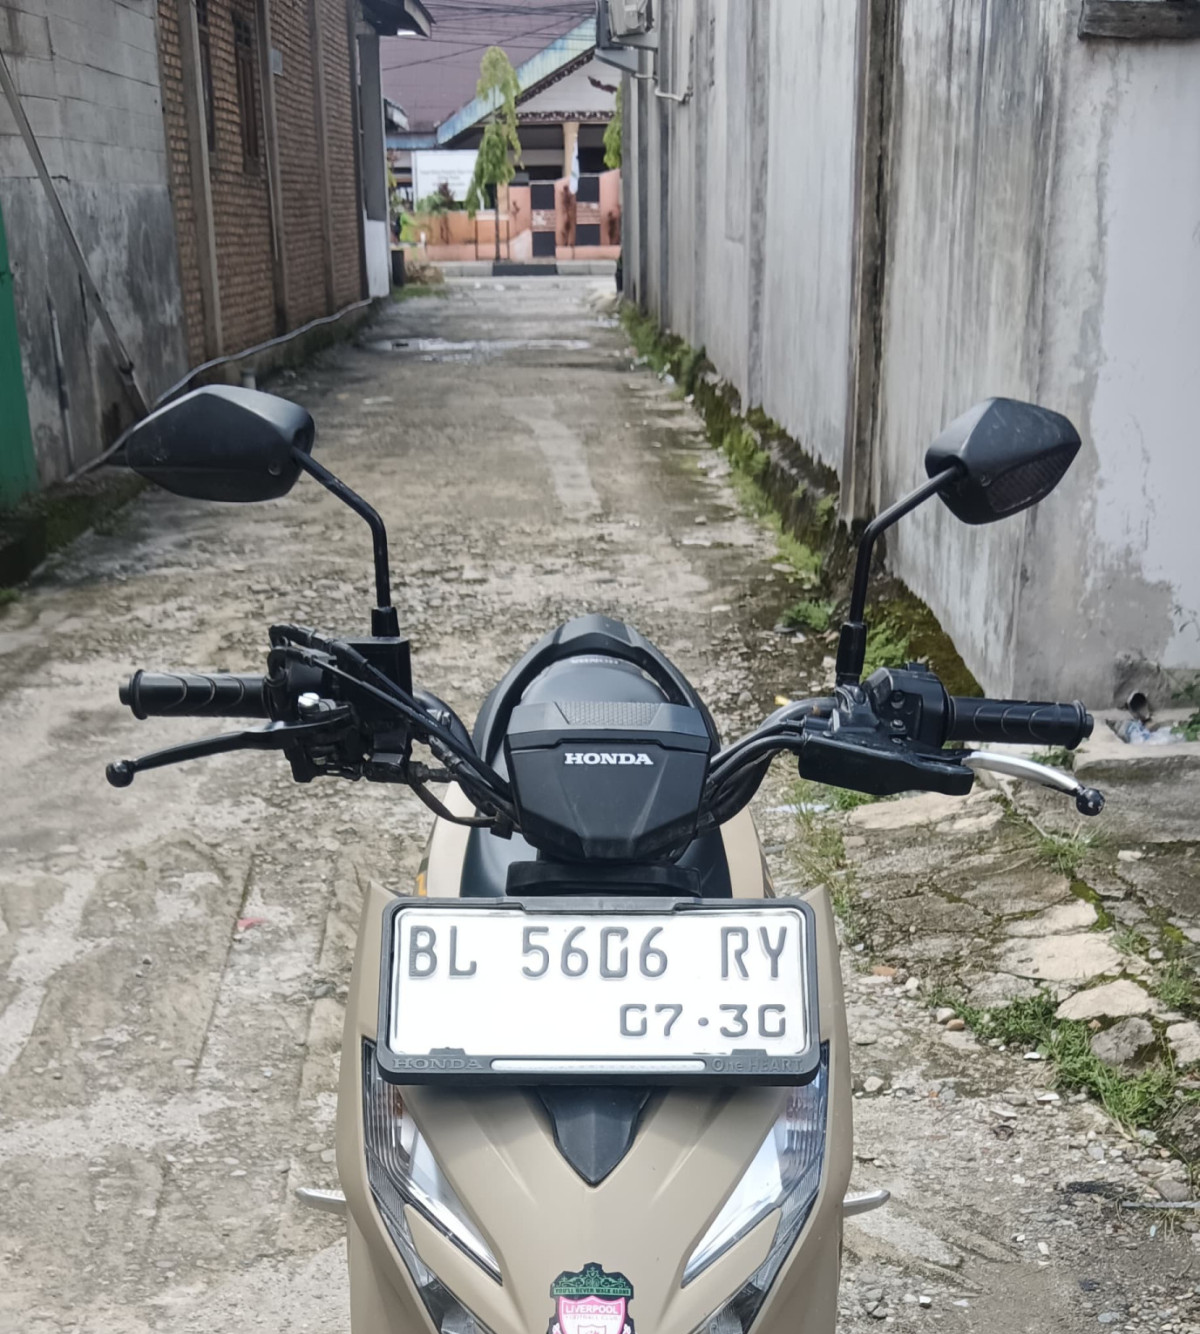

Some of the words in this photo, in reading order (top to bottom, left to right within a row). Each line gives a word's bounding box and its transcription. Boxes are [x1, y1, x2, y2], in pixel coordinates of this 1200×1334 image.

[564, 752, 654, 765] HONDA
[408, 925, 478, 979] BL
[521, 925, 669, 979] 5606
[720, 925, 788, 979] RY
[392, 1058, 485, 1070] HONDA
[711, 1058, 745, 1072] One
[565, 1304, 619, 1314] LIVERPOOL
